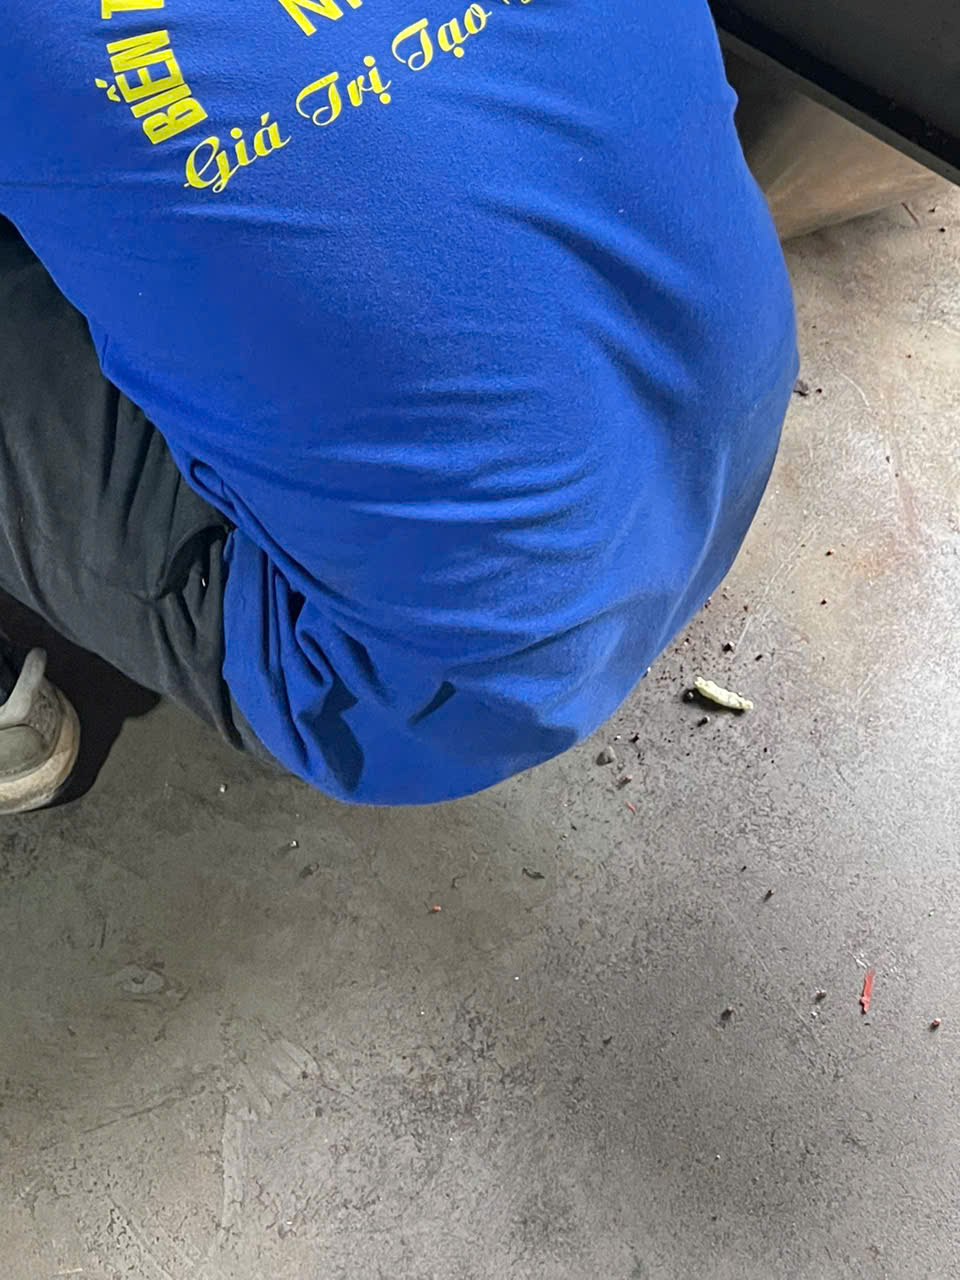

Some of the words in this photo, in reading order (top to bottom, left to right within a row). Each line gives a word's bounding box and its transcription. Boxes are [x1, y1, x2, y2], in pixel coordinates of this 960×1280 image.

[94, 29, 209, 145] BIẾN
[183, 111, 292, 194] Giá
[294, 55, 393, 127] Trị
[390, 3, 494, 59] Tạo
